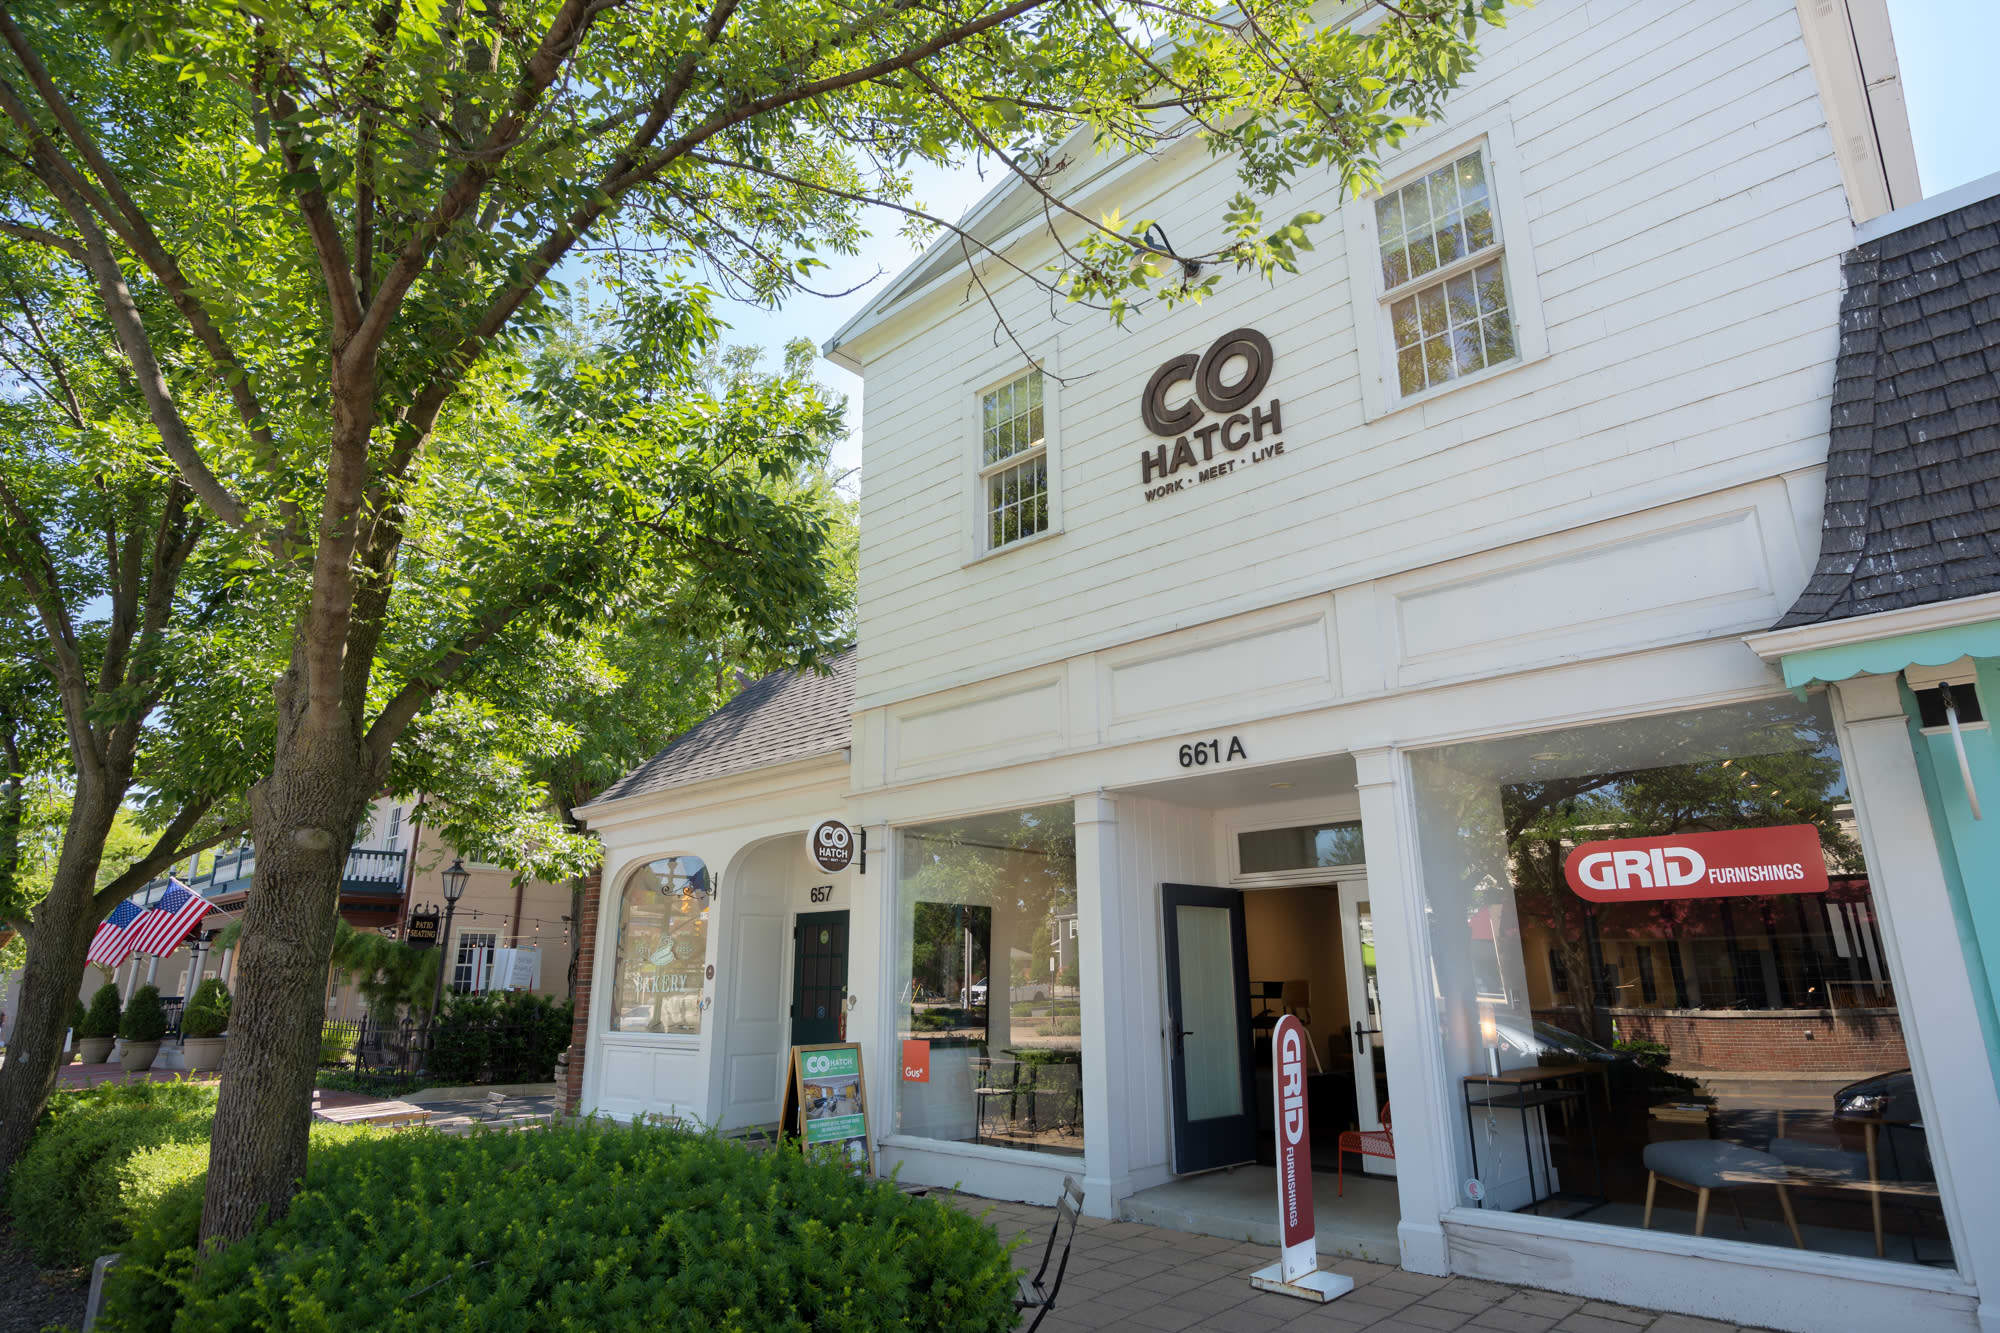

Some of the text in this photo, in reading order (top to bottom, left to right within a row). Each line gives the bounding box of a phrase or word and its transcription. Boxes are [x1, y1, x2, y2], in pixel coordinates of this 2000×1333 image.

[1142, 328, 1274, 437] CO
[1141, 399, 1282, 484] HATCH
[1145, 442, 1284, 502] WORK MEET LIVE
[819, 826, 849, 848] CO
[819, 847, 848, 858] HATCH
[1578, 847, 1804, 890] GRID FURNISHINGS
[811, 886, 833, 903] 657
[409, 930, 436, 938] SEATING
[415, 920, 434, 929] PATIO
[635, 975, 688, 993] BAKERY
[1282, 1028, 1304, 1228] GRID FURNISHINGS
